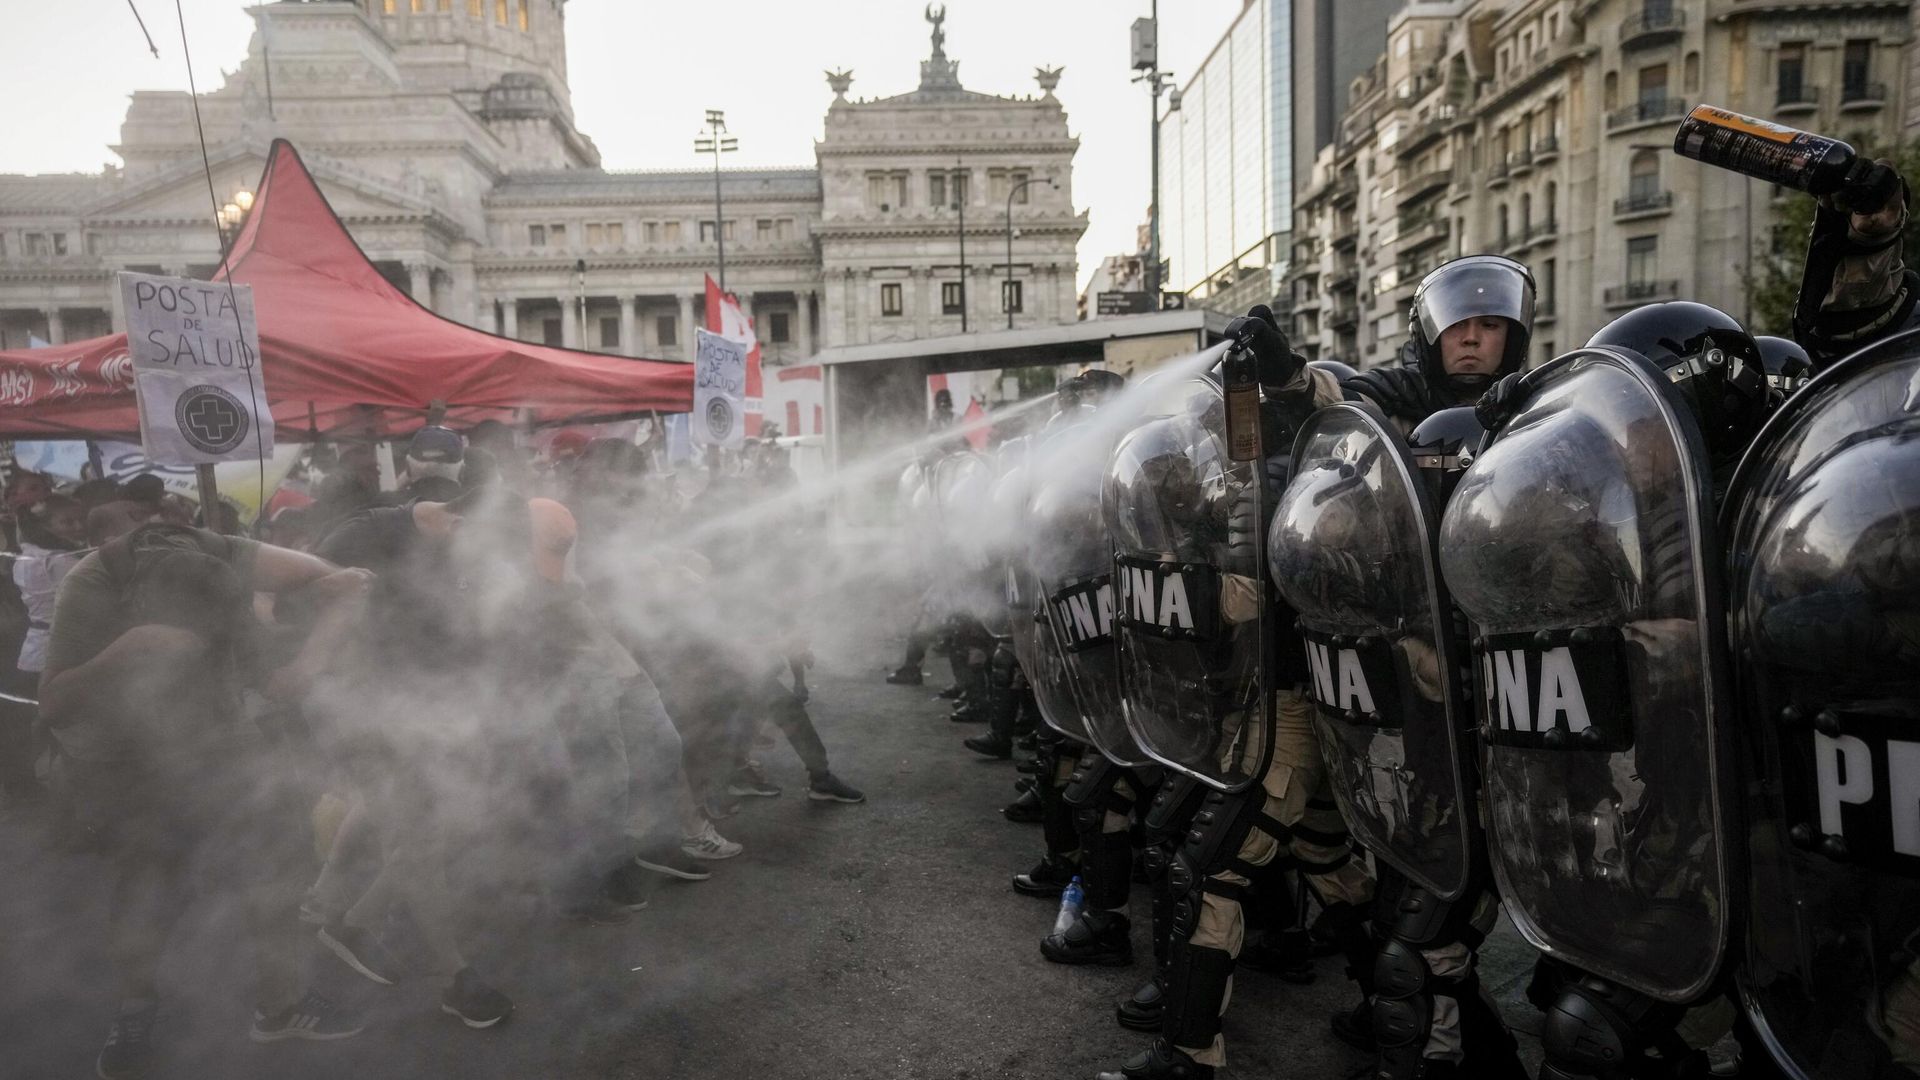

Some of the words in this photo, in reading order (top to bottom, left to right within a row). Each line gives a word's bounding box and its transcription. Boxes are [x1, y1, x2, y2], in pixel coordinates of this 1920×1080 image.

[135, 281, 239, 317] POSTA
[183, 317, 205, 331] DE
[147, 329, 255, 370] SALUD
[703, 339, 741, 366] POSTA
[100, 354, 136, 391] MS
[698, 367, 737, 392] SALUD
[1120, 564, 1194, 629] PNA
[1303, 637, 1376, 713] NA
[1483, 646, 1592, 733] PNA
